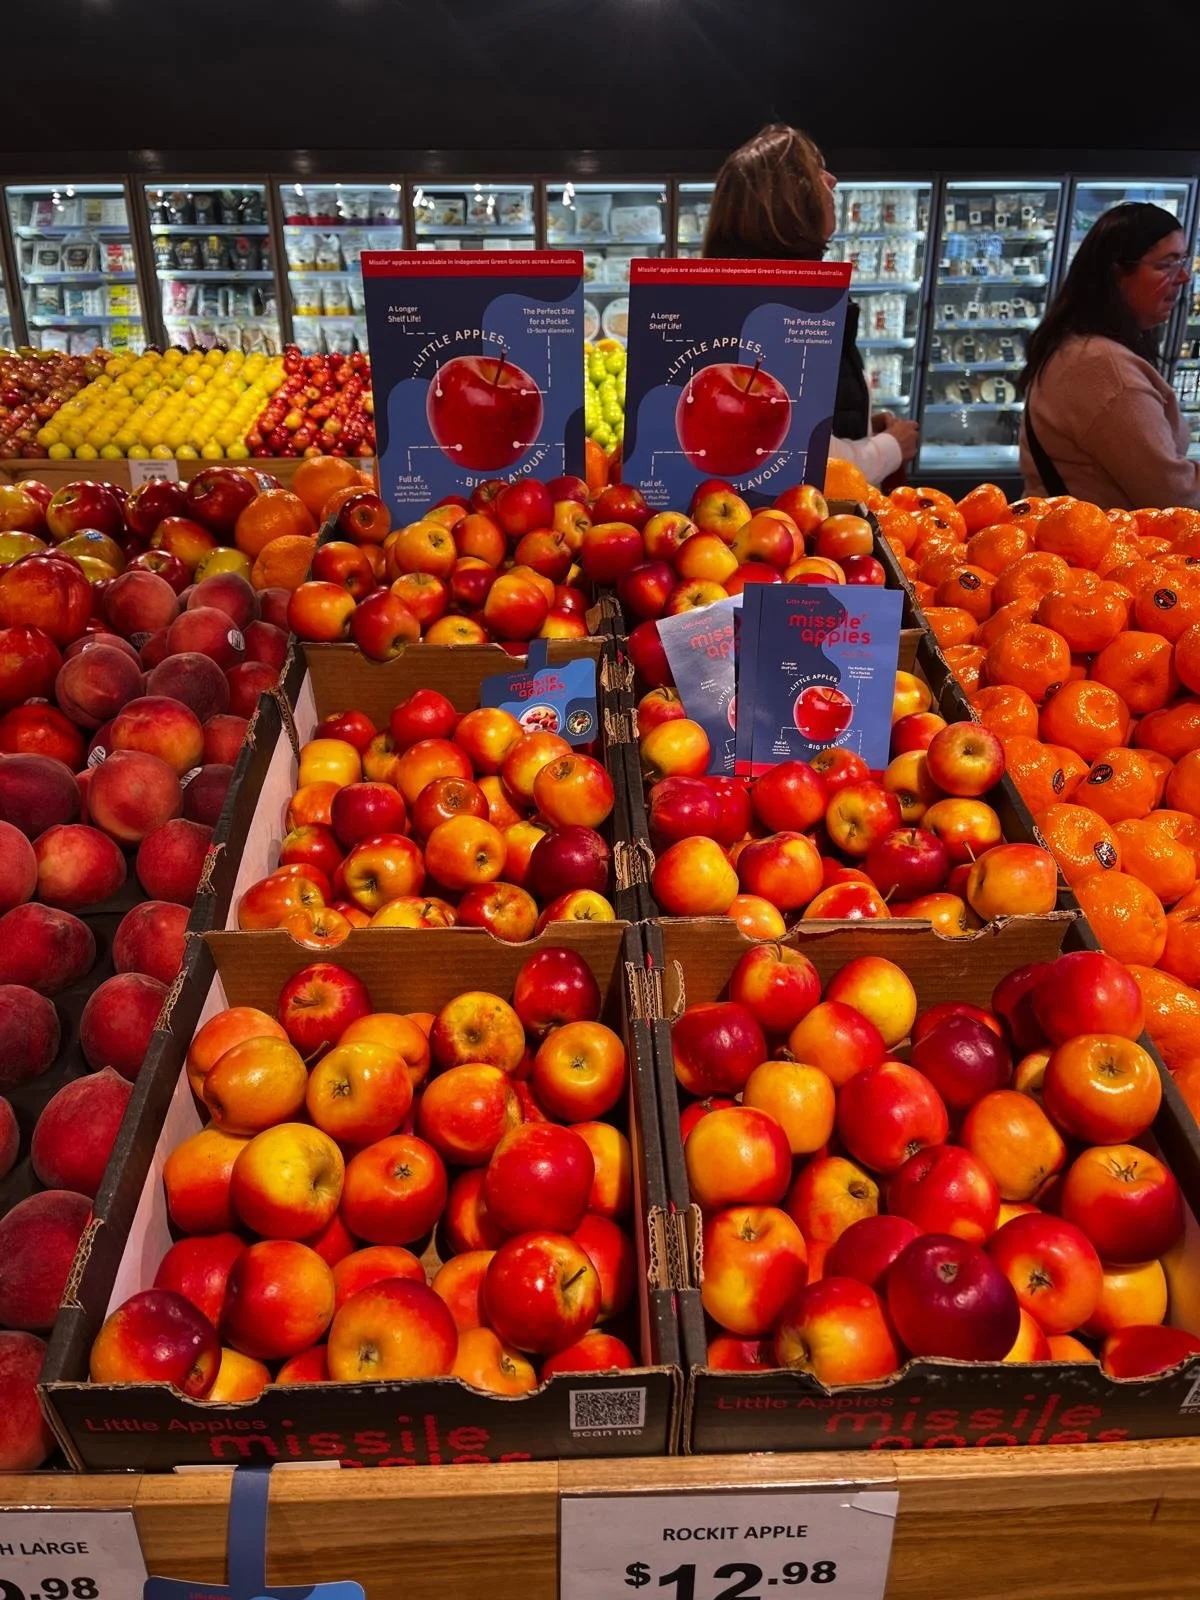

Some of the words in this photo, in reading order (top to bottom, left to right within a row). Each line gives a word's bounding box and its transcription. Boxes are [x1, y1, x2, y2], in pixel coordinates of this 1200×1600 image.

[394, 306, 418, 314] Longer
[657, 313, 680, 321] Longer
[796, 318, 820, 326] Perfect
[690, 624, 734, 650] miss
[800, 629, 871, 648] apples
[519, 682, 565, 698] apples
[718, 1396, 787, 1410] Little
[798, 1396, 895, 1411] Apples
[825, 1394, 1102, 1432] missile
[86, 1418, 159, 1432] Little
[168, 1418, 268, 1433] Apples
[209, 1414, 490, 1457] missile
[572, 1430, 612, 1438] scan
[663, 1526, 739, 1541] ROCKIT
[744, 1525, 809, 1539] APPLE
[20, 1542, 89, 1555] LARGE
